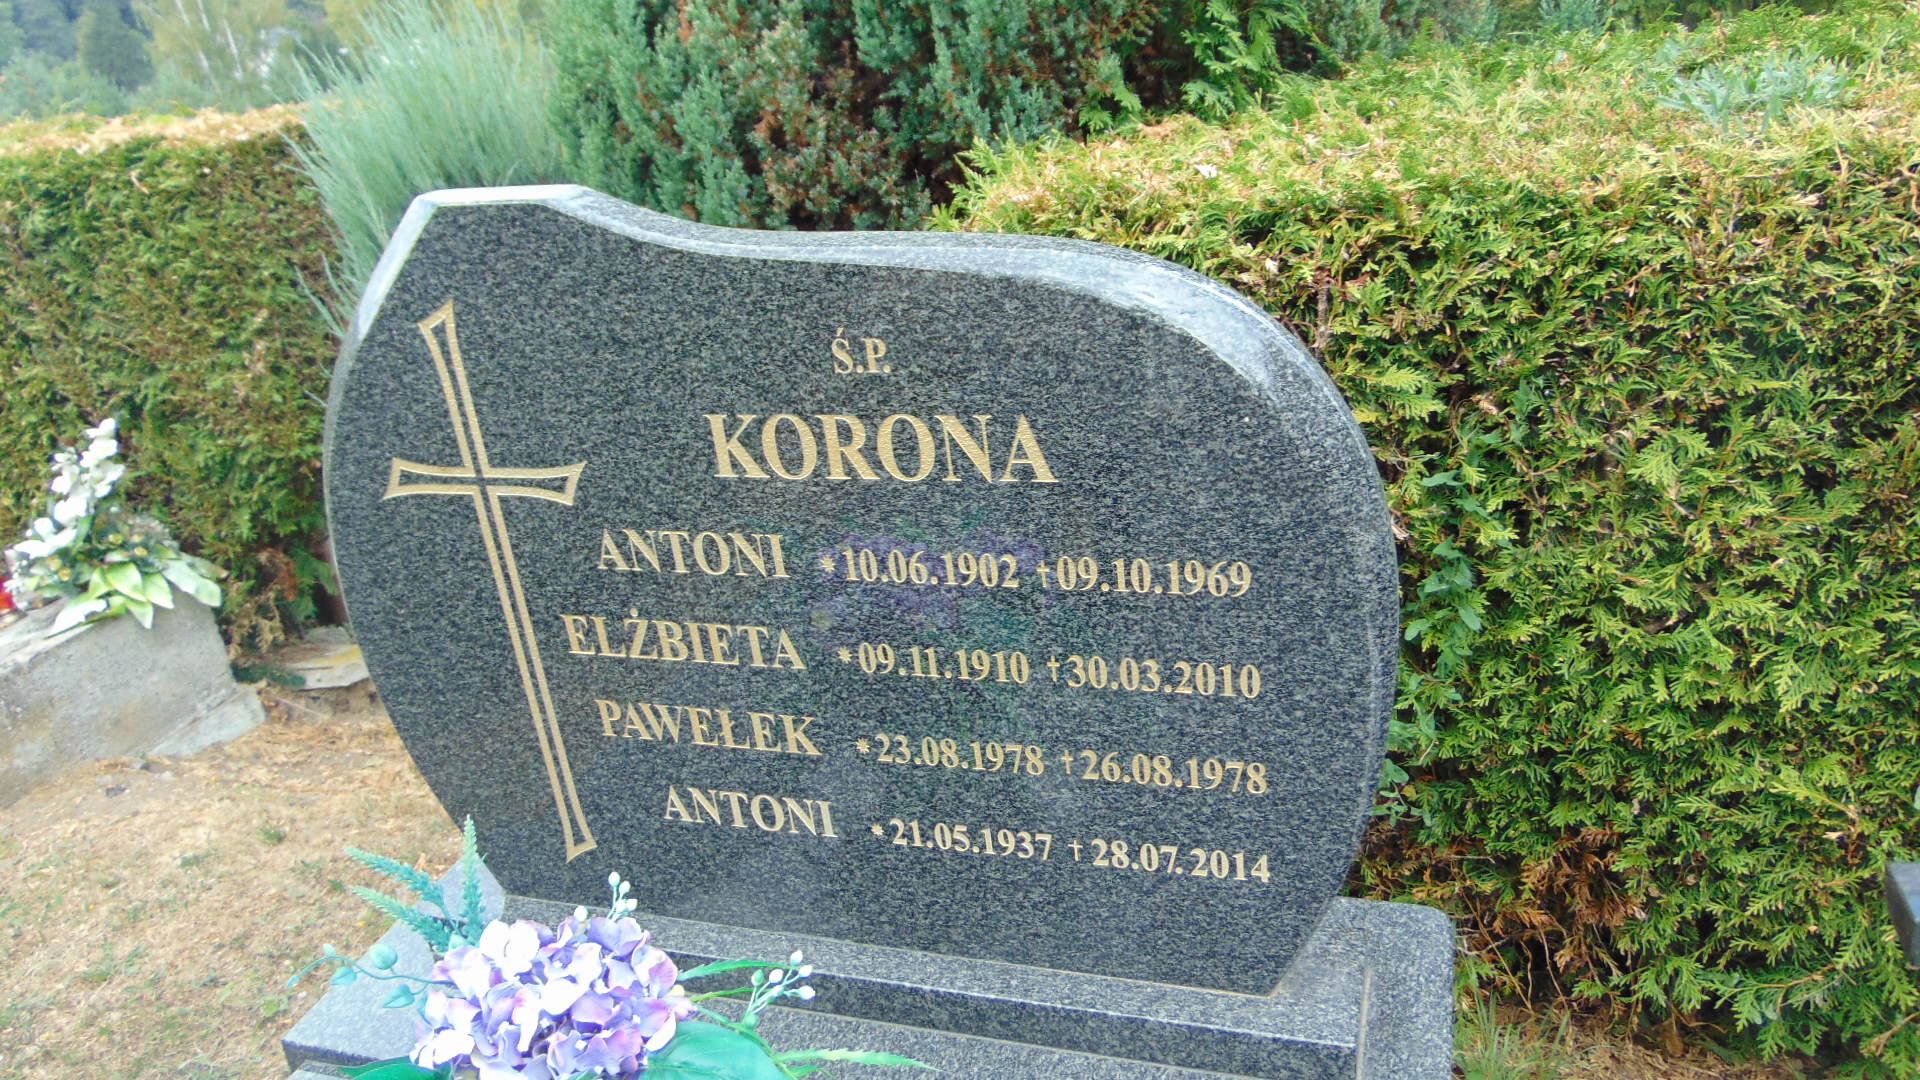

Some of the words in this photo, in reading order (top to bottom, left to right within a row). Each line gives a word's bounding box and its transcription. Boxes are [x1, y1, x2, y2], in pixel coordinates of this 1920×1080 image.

[831, 327, 892, 376] Ś.P.
[705, 412, 1060, 483] KORONA
[597, 528, 790, 578] ANTONI
[560, 608, 806, 671] ELŻBIETA
[595, 699, 822, 757] PAWEŁEK
[663, 786, 838, 839] ANTONI
